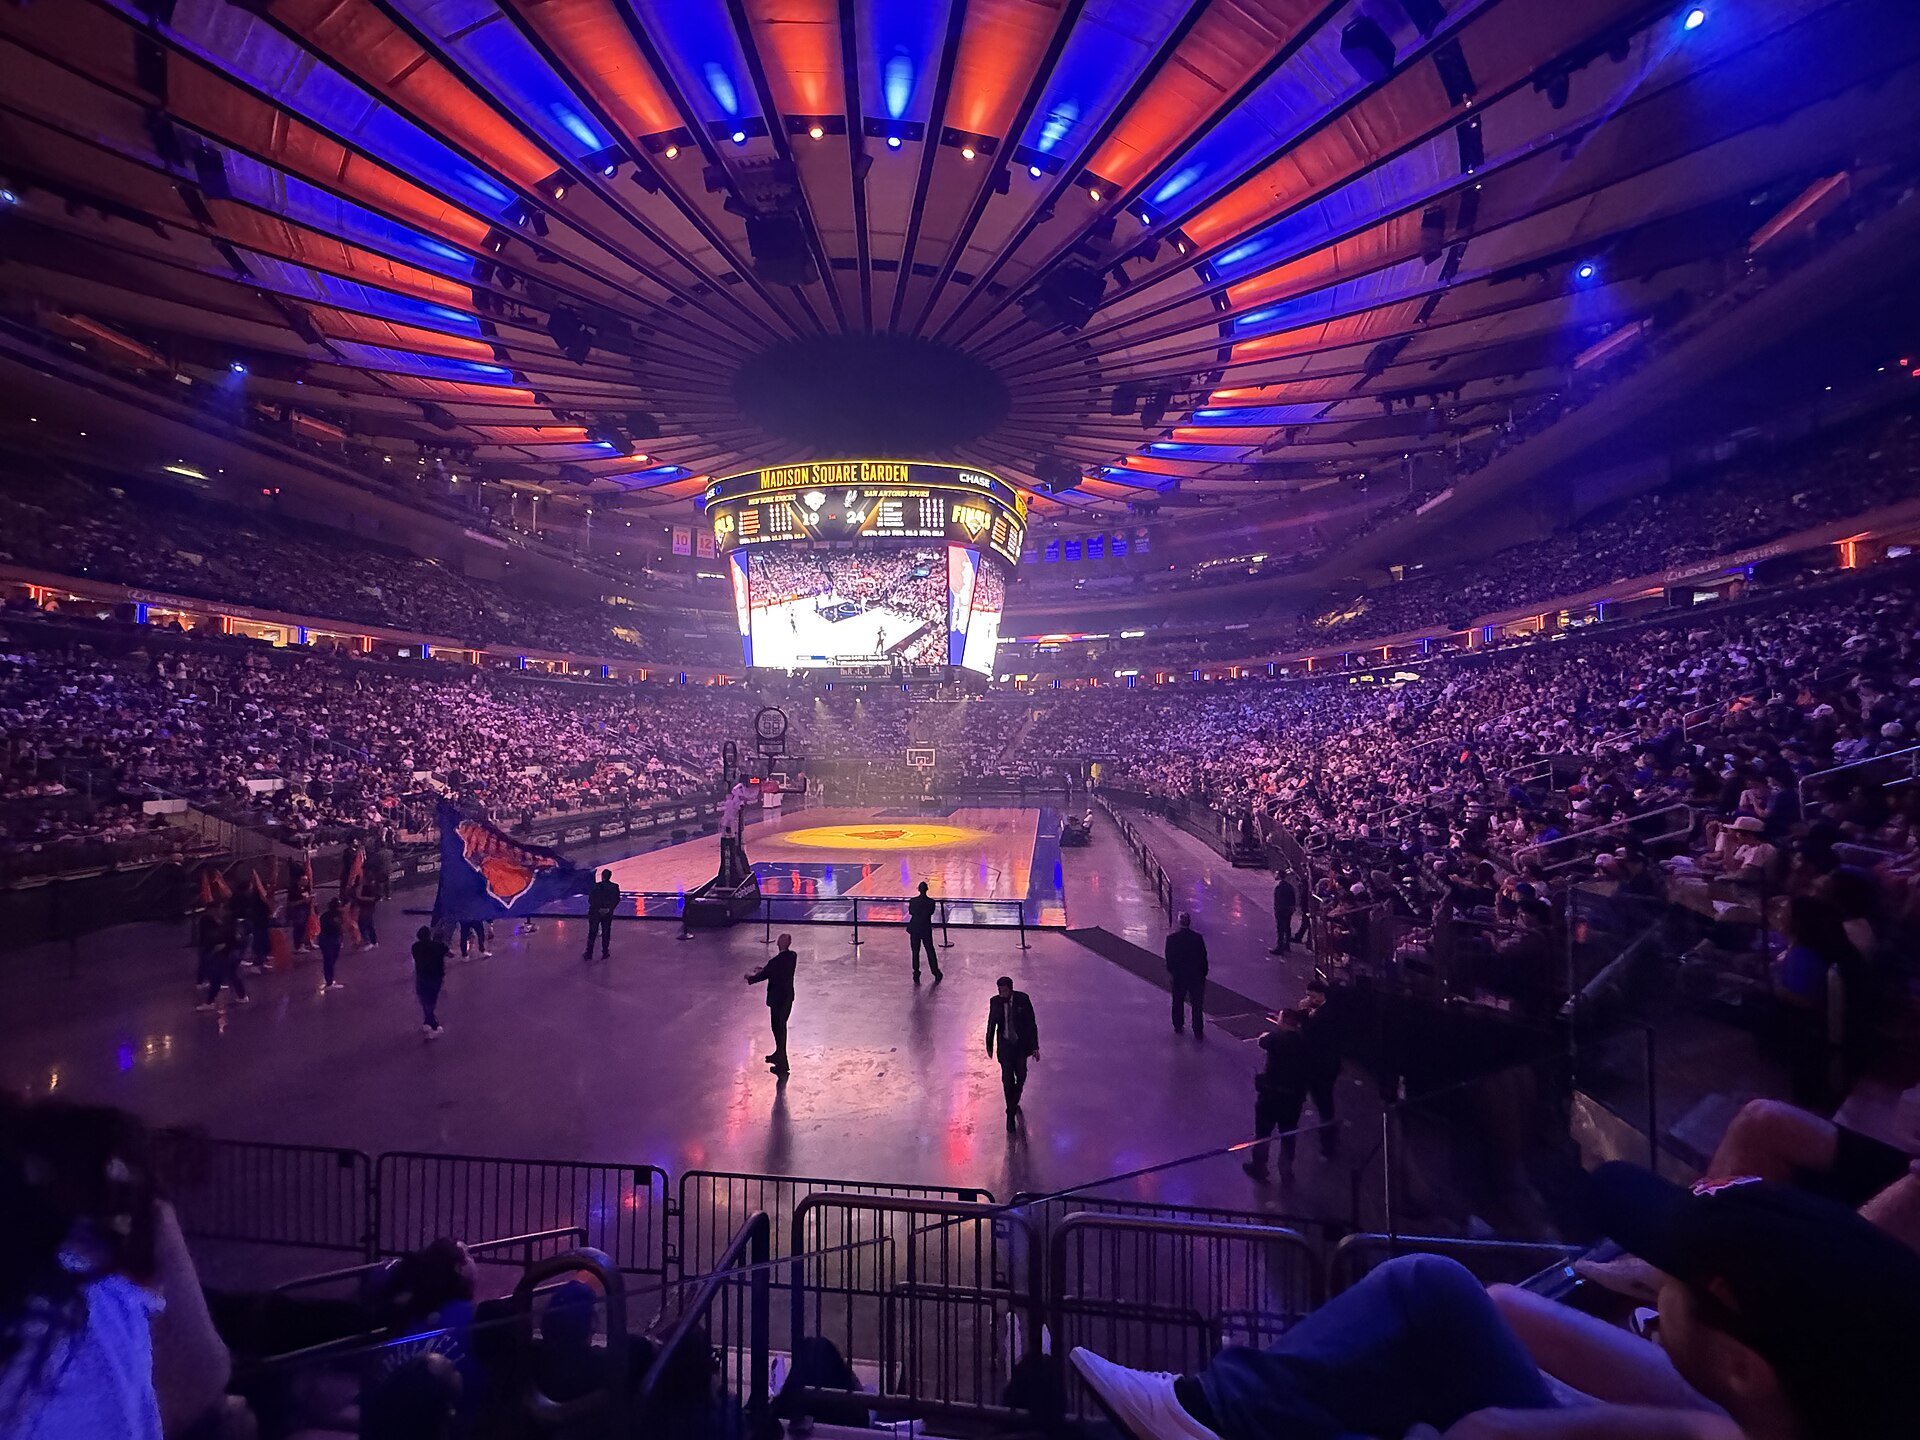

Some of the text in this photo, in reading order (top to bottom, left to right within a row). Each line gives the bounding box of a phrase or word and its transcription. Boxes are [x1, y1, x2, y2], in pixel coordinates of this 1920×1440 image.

[760, 463, 909, 490] MADISON SQUARE GARDEN
[959, 473, 991, 488] CHASE
[863, 490, 878, 498] SAN
[878, 490, 908, 498] ANTONIO
[802, 512, 820, 527] 19
[846, 511, 866, 525] 24
[676, 534, 688, 546] 10
[700, 537, 712, 550] 12
